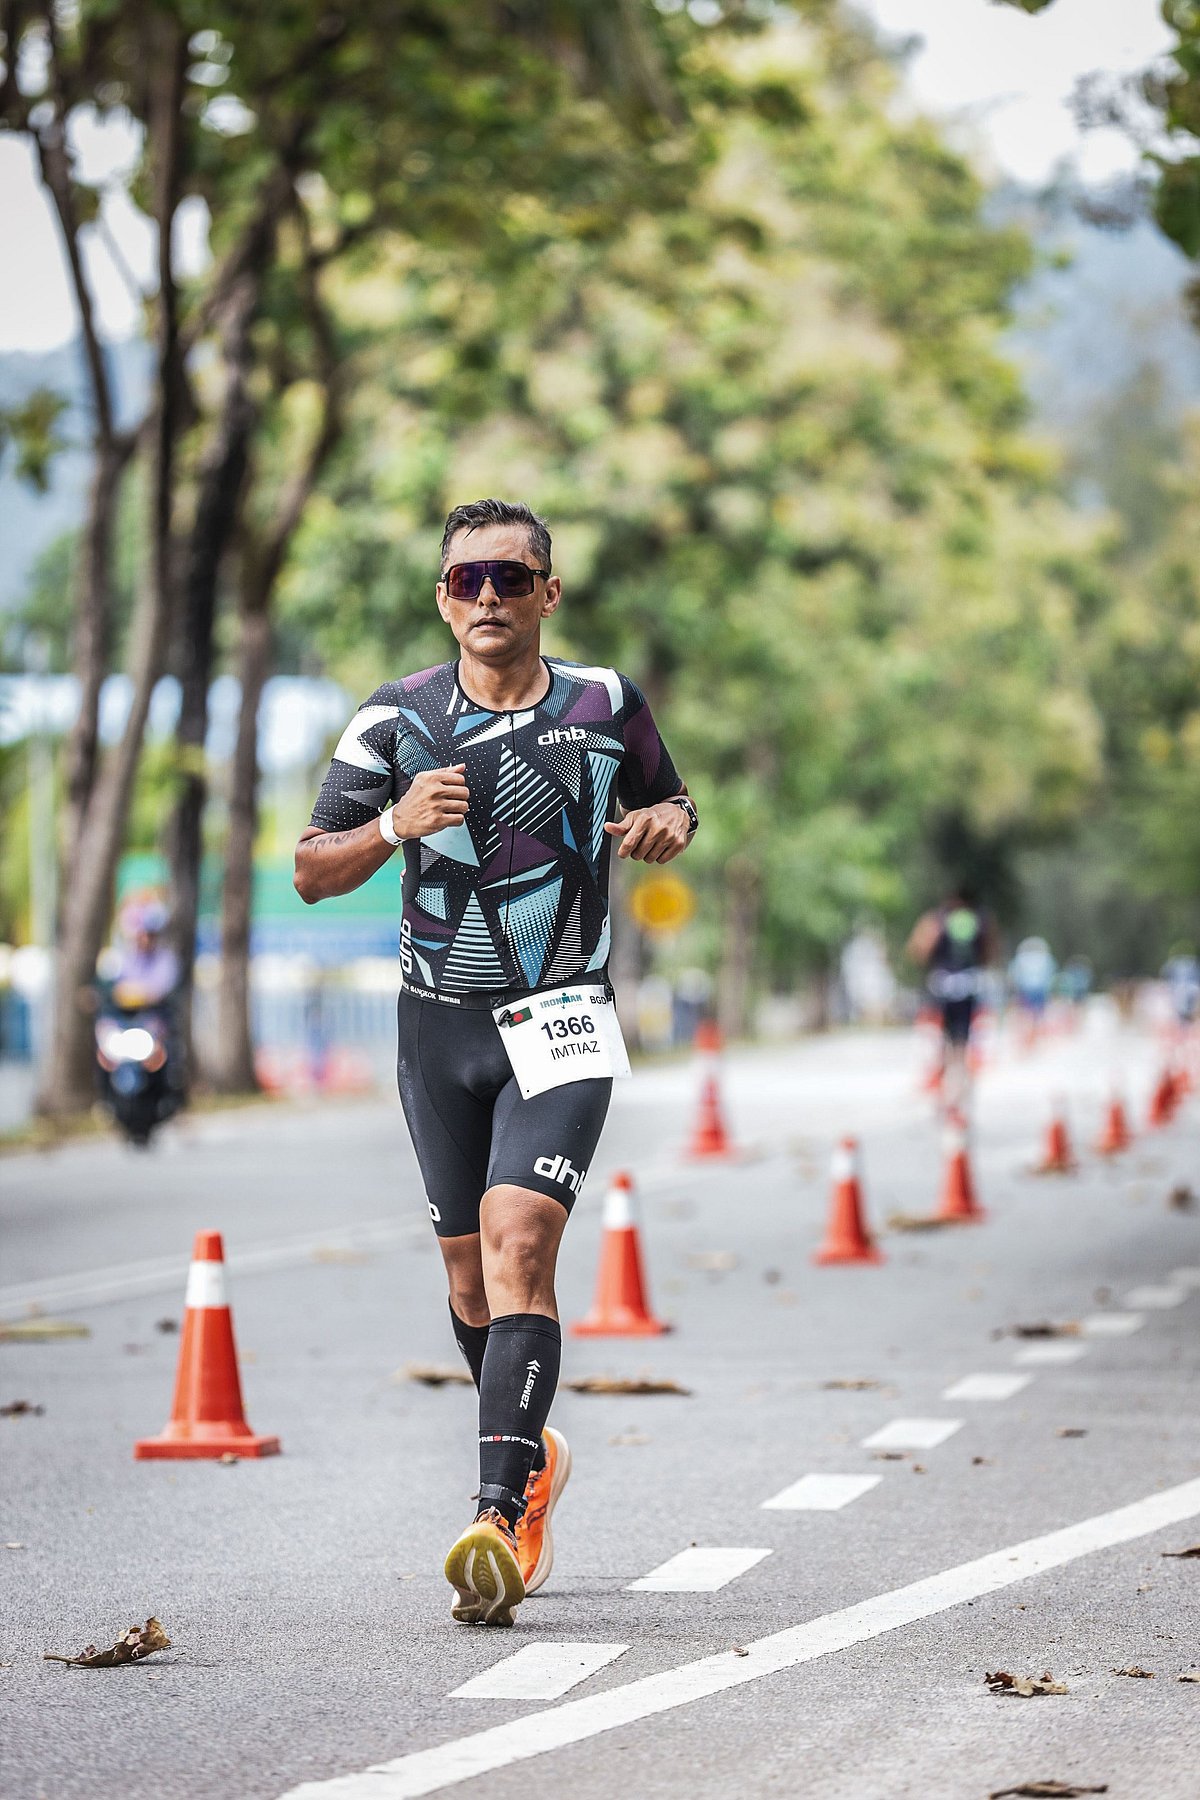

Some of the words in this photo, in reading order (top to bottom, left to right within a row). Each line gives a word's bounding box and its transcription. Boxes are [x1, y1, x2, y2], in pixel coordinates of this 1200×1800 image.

[537, 726, 587, 745] dhb
[540, 993, 583, 1008] IRONMAN
[590, 995, 607, 1004] BGD
[541, 1014, 595, 1040] 1366
[550, 1041, 600, 1060] IMTIAZ
